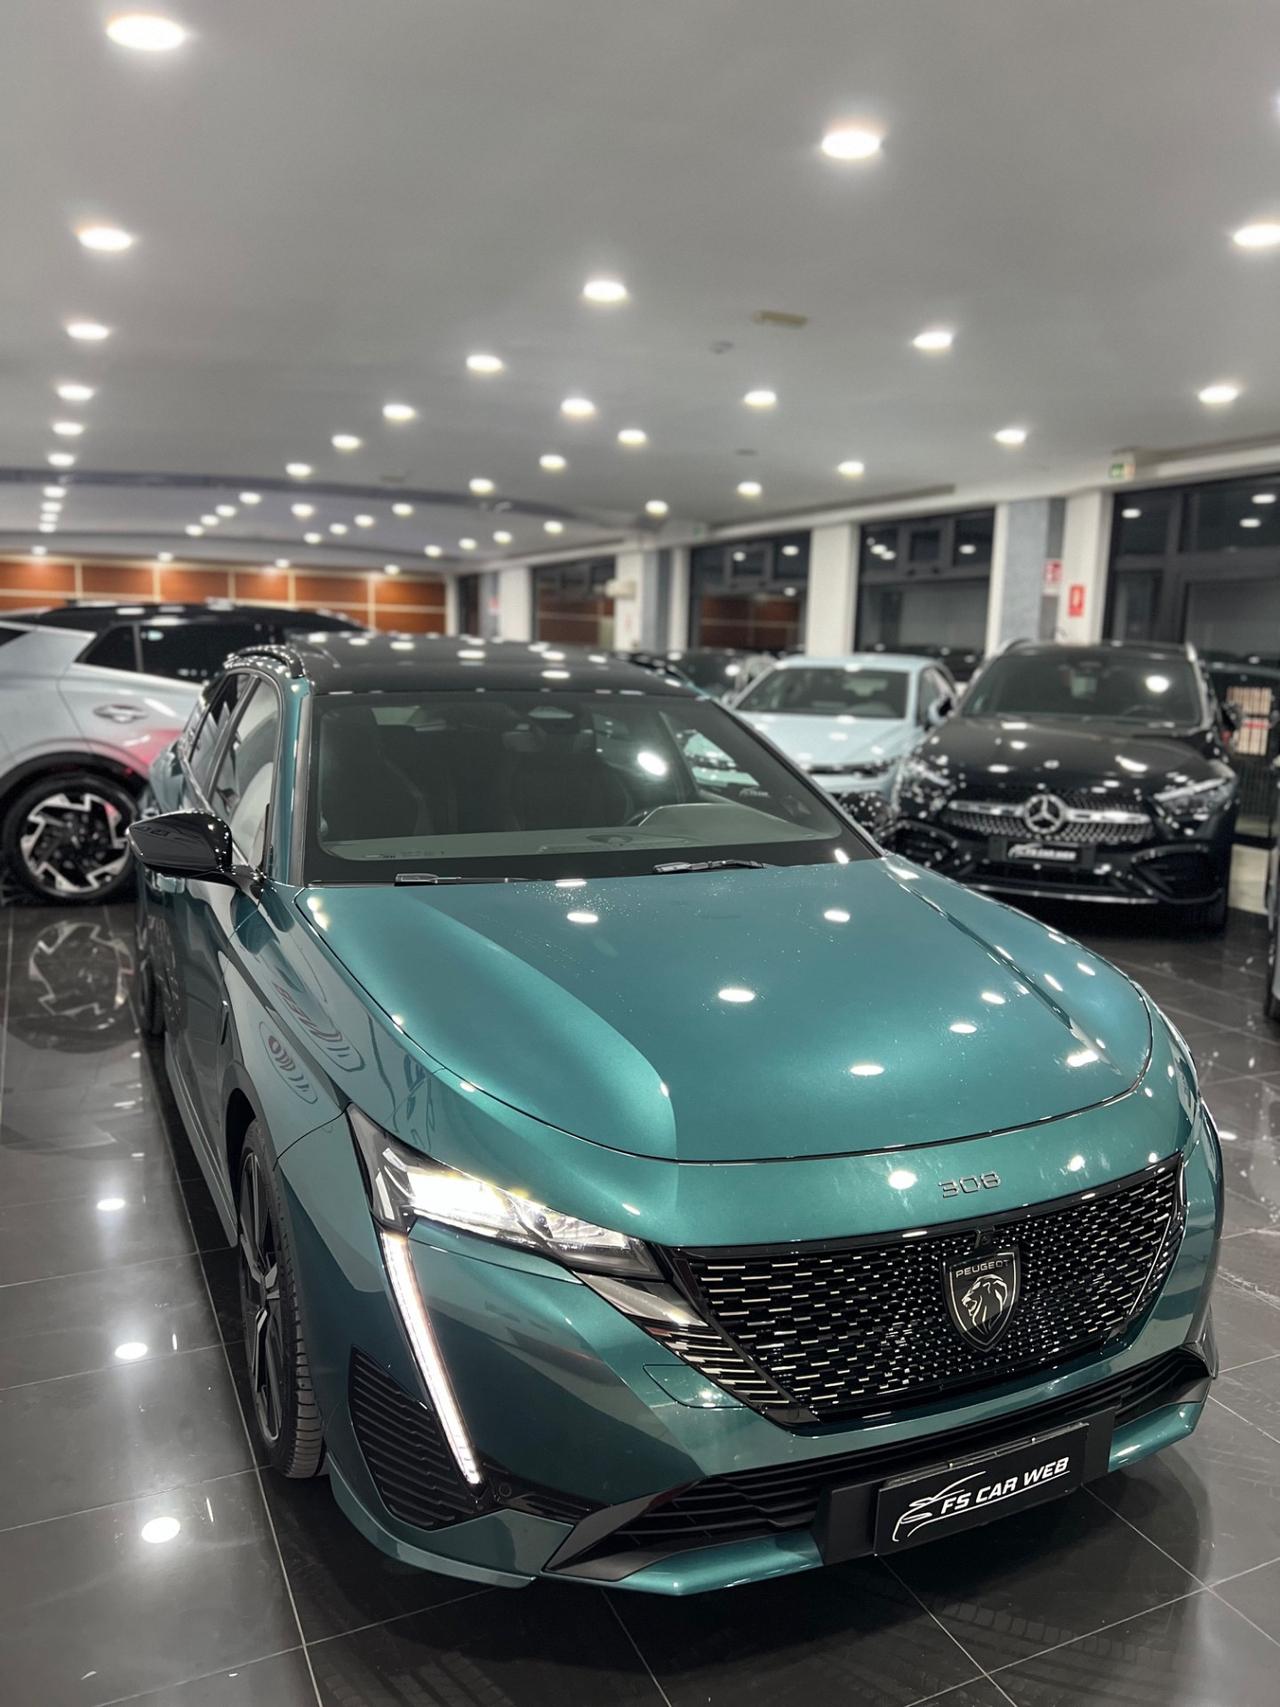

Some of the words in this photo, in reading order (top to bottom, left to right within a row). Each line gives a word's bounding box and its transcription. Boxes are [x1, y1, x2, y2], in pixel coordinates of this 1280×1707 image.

[938, 1171, 1001, 1198] 308
[955, 1260, 1009, 1278] PEUGEOT
[941, 1492, 972, 1514] FS
[975, 1477, 1018, 1503] CAR
[1023, 1457, 1070, 1486] WEB
